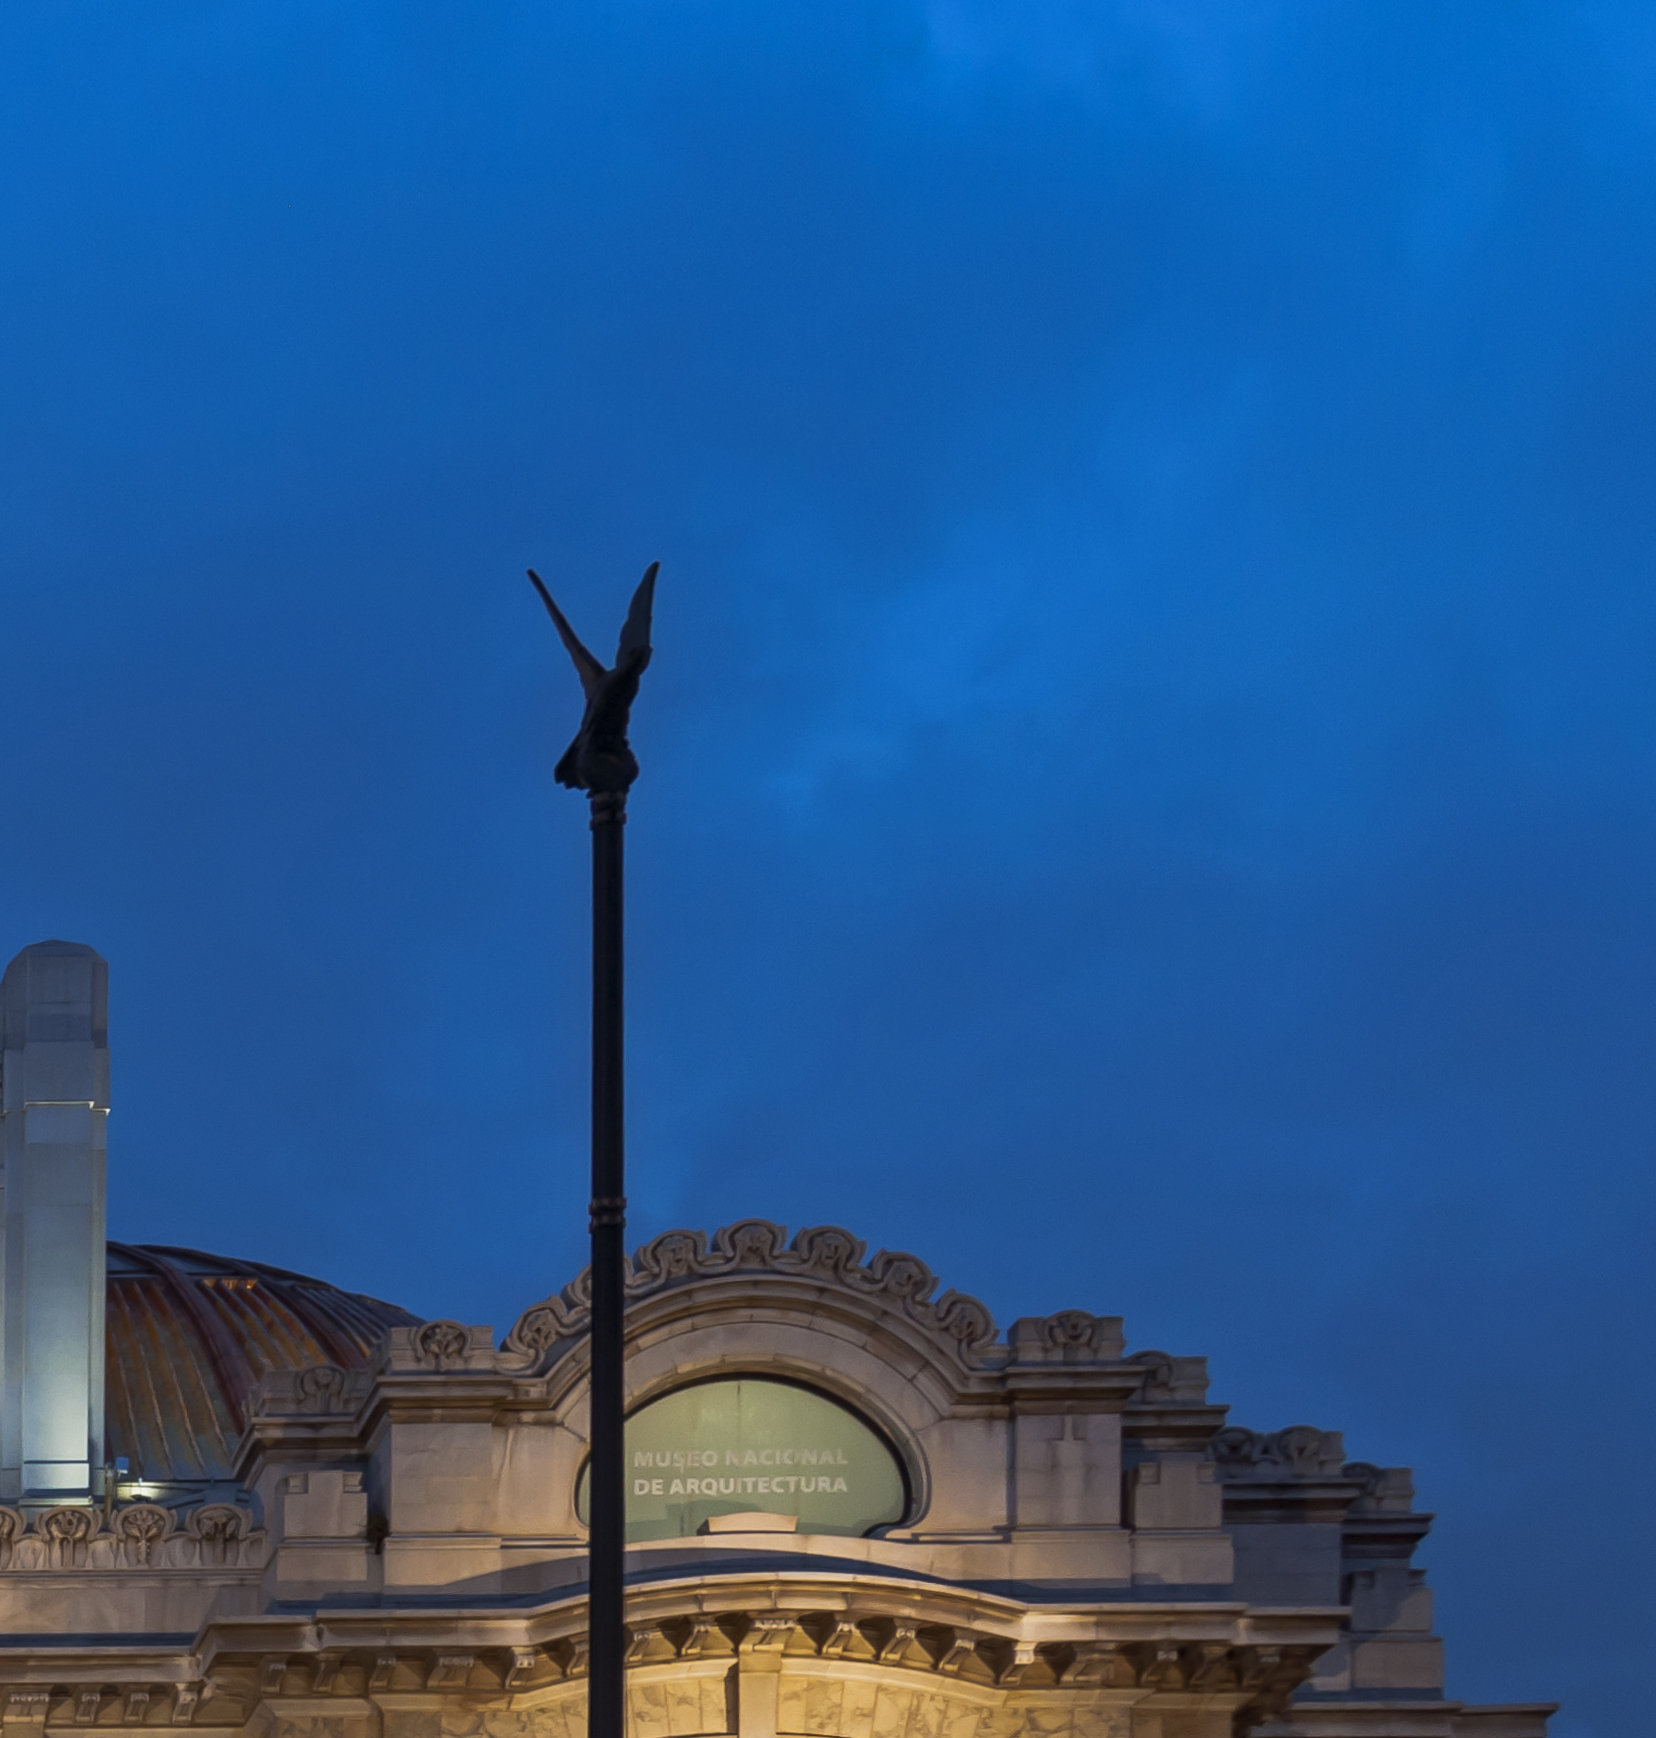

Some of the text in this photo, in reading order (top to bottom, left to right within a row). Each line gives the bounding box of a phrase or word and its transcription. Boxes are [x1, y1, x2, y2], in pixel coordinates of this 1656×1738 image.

[633, 1449, 849, 1468] MUSEO NACIONAL
[633, 1475, 849, 1496] DE ARQUITECTURA
